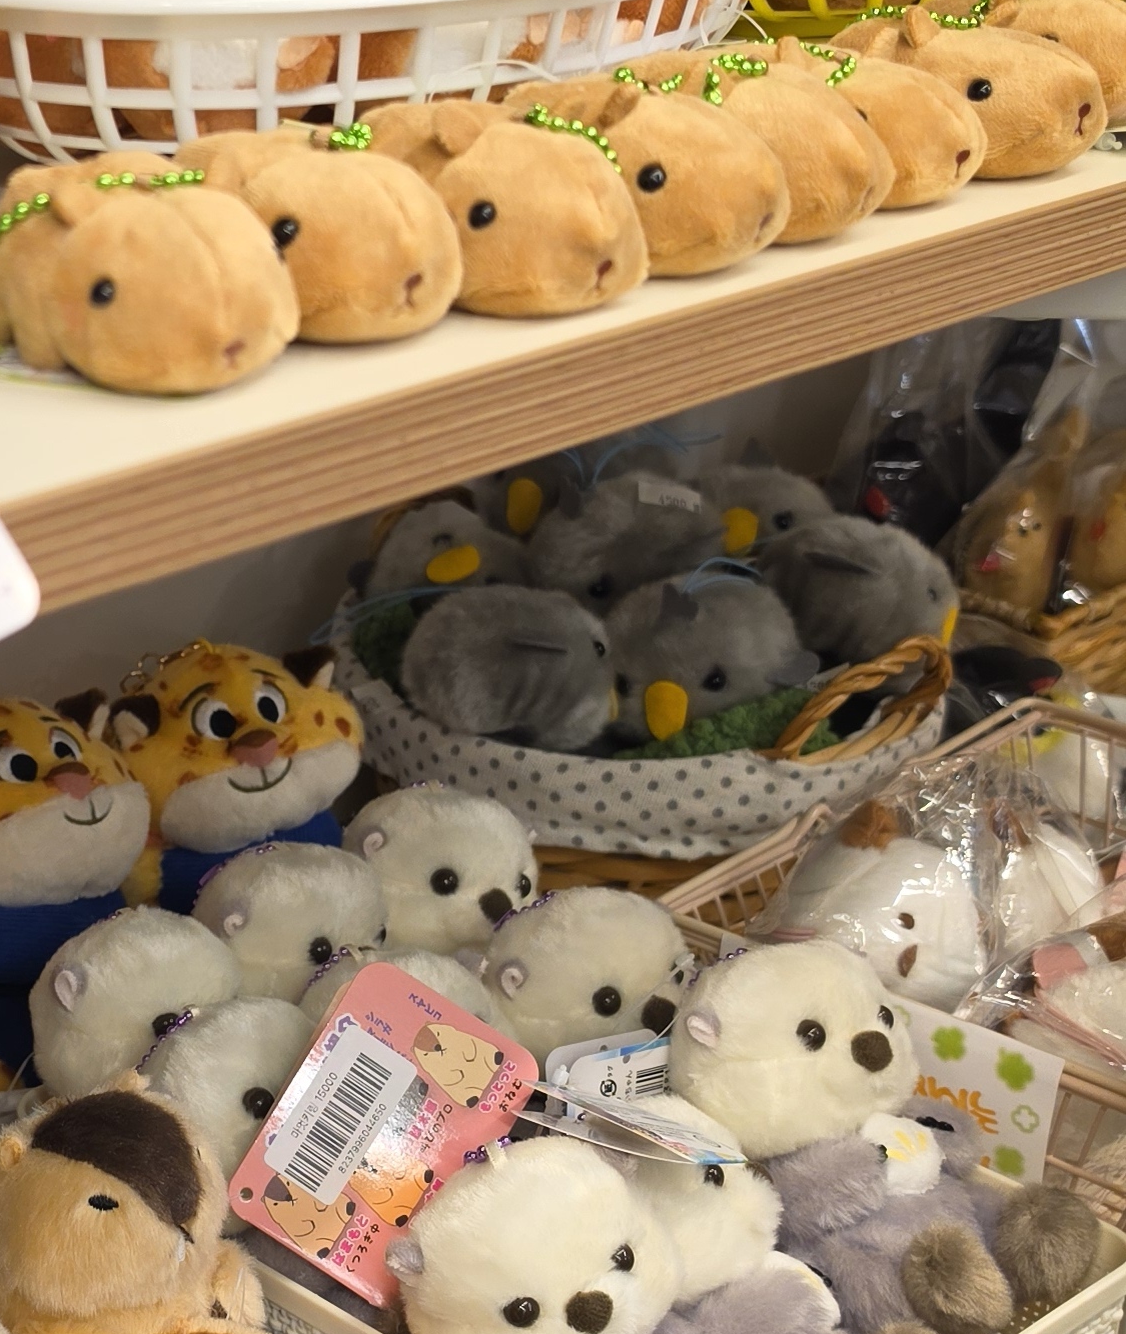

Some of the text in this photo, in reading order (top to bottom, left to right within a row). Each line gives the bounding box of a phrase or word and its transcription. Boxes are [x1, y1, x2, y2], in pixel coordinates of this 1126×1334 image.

[313, 1070, 339, 1103] 15000
[476, 1058, 518, 1115] もっとっと
[495, 1076, 525, 1113] おねむ
[337, 1101, 388, 1175] 8237996044650
[329, 1211, 371, 1268] はまもと
[343, 1221, 383, 1275] くつろぎ中
